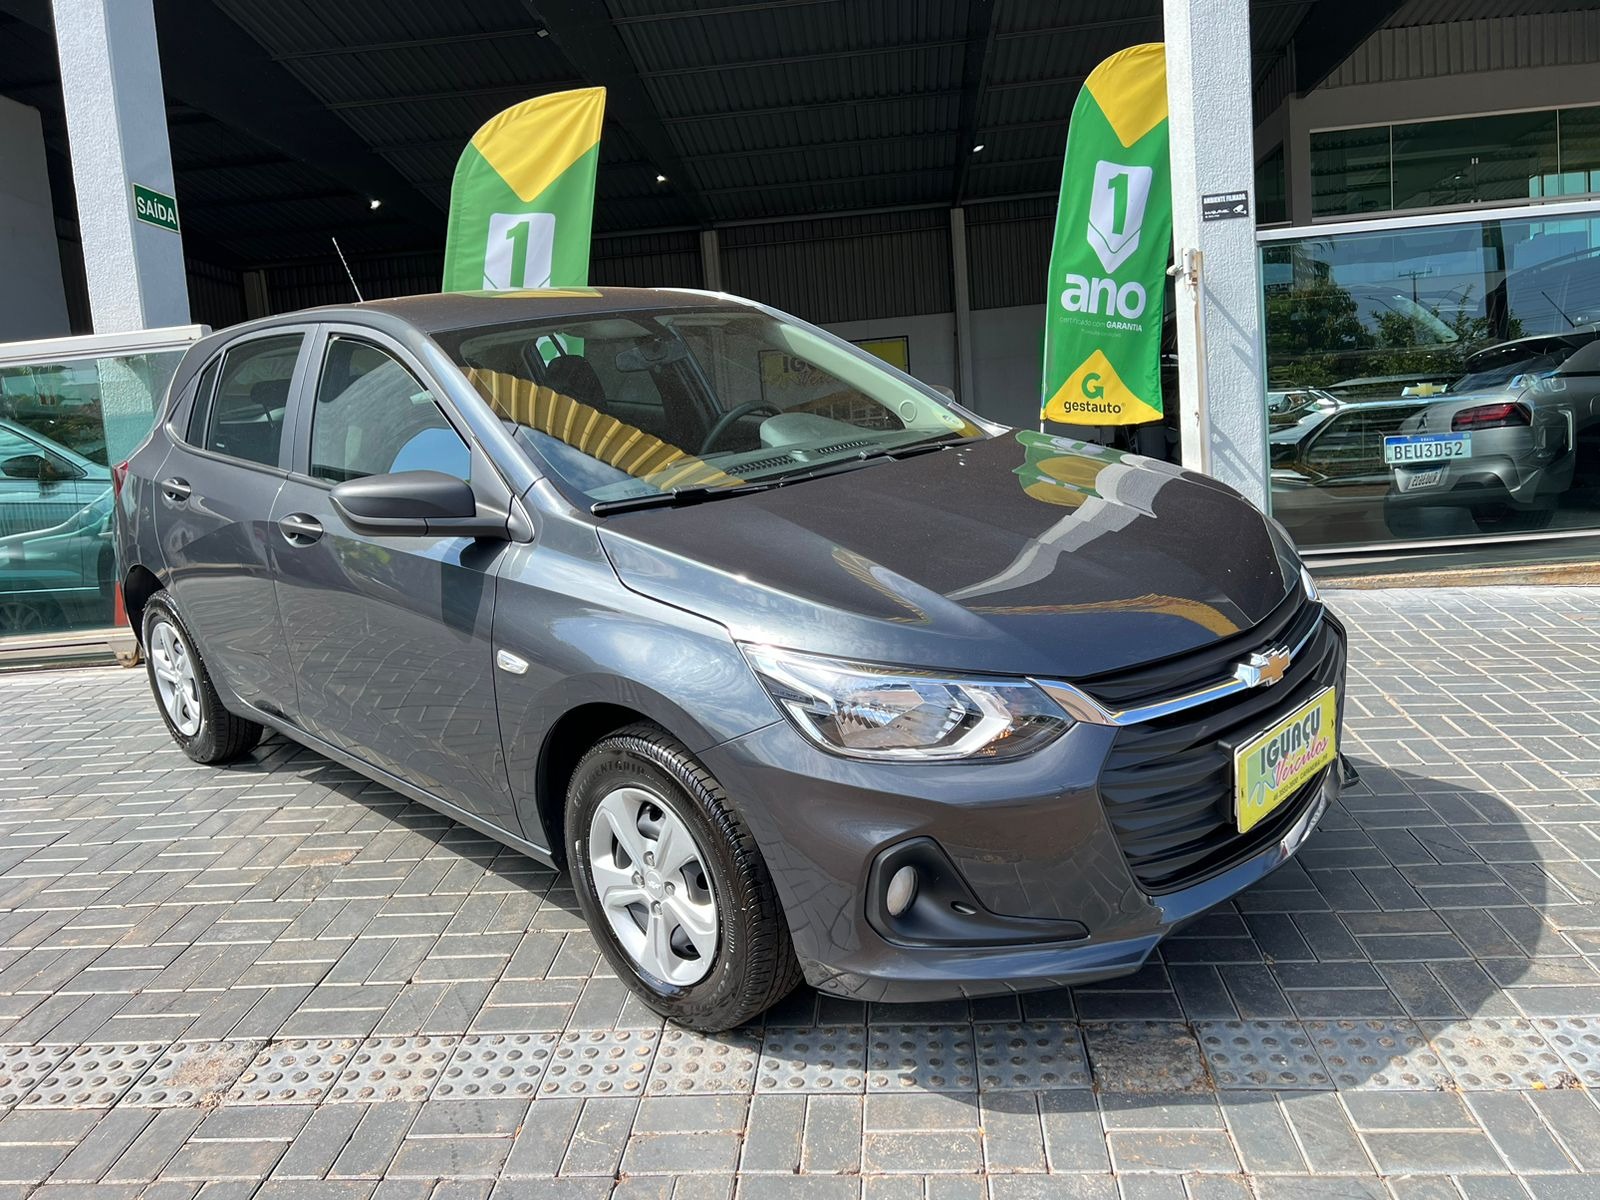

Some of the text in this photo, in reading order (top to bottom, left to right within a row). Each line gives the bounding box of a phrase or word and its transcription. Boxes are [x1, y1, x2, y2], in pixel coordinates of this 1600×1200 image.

[136, 196, 176, 225] SAÍDA
[1107, 172, 1129, 236] 1
[505, 220, 531, 288] 1
[1061, 273, 1147, 319] ano
[1106, 320, 1143, 332] GARANTIA
[1063, 400, 1121, 414] gestauto
[1394, 442, 1463, 460] BEU3D52
[1261, 706, 1320, 775] IGUAÇU
